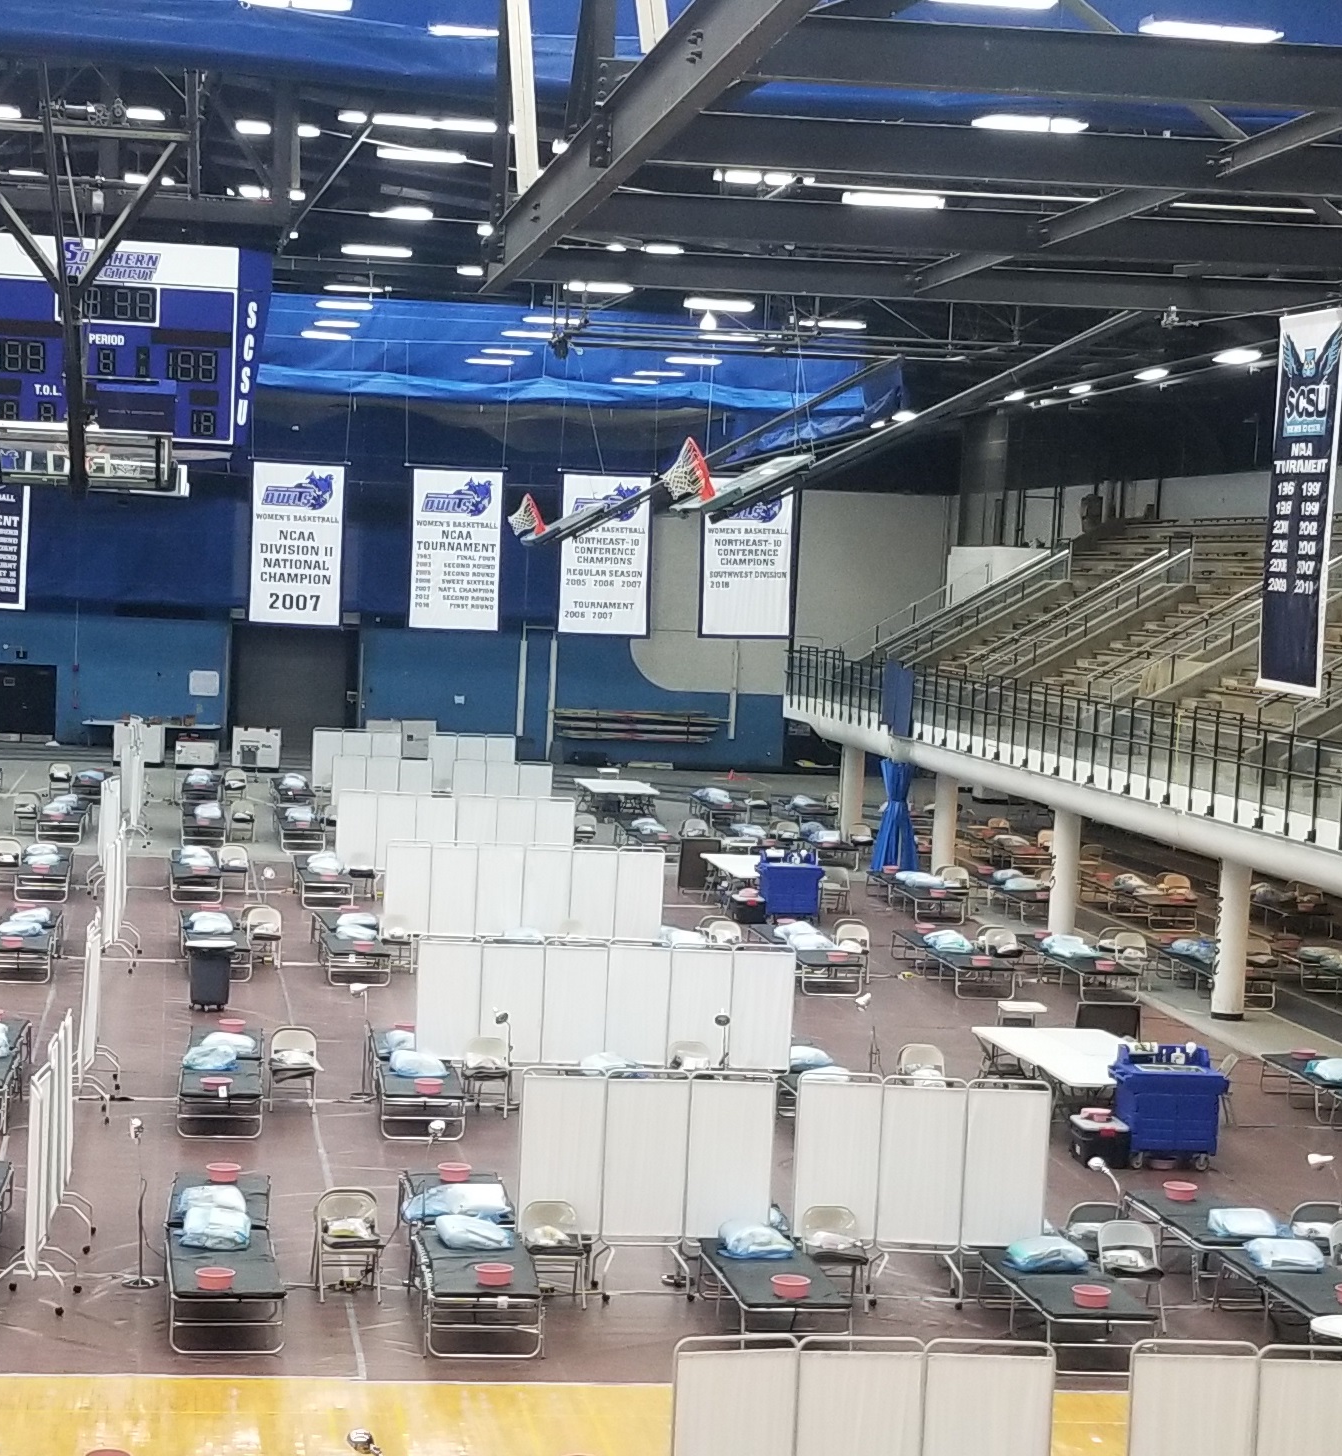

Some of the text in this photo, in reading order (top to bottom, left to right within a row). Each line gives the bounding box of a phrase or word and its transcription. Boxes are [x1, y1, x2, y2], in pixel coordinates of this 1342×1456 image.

[64, 241, 159, 267] SOHERN
[89, 333, 124, 345] PERIOD
[237, 302, 257, 426] SCSU
[34, 383, 62, 396] T.O.L.
[1285, 385, 1330, 421] SCSU
[255, 513, 339, 524] WOMEN'S BASKETBALL
[416, 520, 498, 530] WOMEN'S BASKETBALL
[279, 530, 315, 542] NCAA
[441, 530, 473, 541] NCAA
[417, 541, 497, 553] TOURNAMENT
[571, 537, 640, 547] NORTHEAST-10
[714, 539, 782, 547] NORTHEAST-10
[260, 543, 333, 557] DIVISION II
[574, 546, 636, 556] CONFERENCE
[717, 548, 778, 557] CONFERENCE
[263, 558, 330, 571] NATIONAL
[576, 556, 633, 565] CHAMPIONS
[720, 558, 776, 566] CHAMPIONS
[260, 571, 331, 585] CHAMPION
[566, 568, 643, 578] REGULAR SEASON
[709, 571, 787, 579] SOUTHWEST DIVISION
[565, 578, 587, 586] 2005
[621, 580, 642, 588] 2007
[269, 592, 321, 611] 2007
[573, 601, 634, 610] TOURNAMENT
[592, 611, 613, 619] 2007
